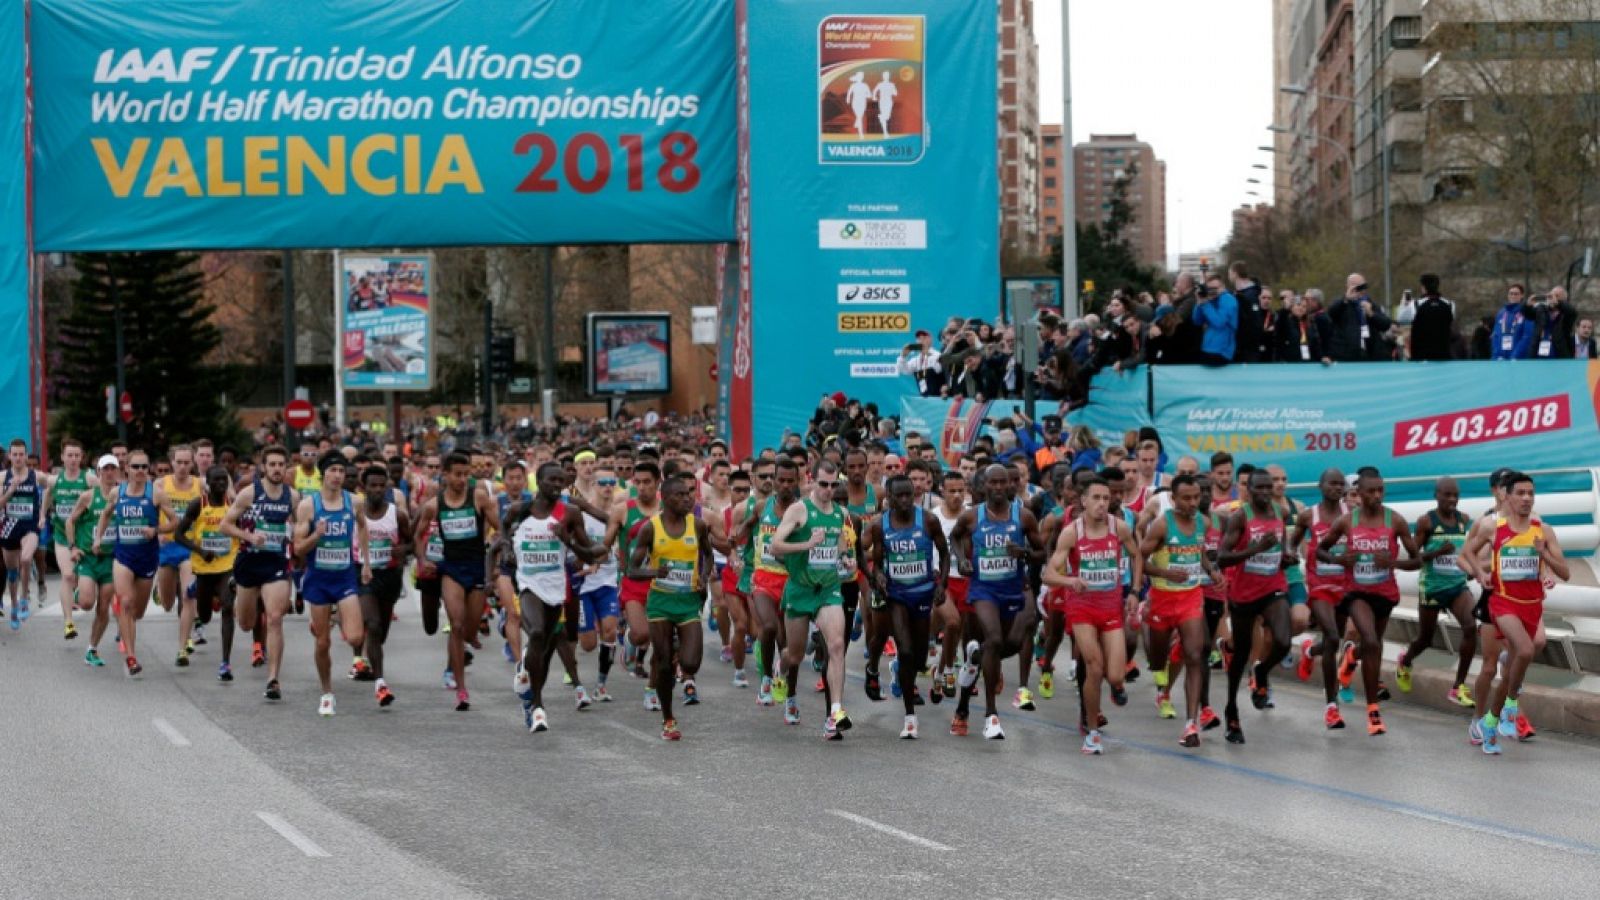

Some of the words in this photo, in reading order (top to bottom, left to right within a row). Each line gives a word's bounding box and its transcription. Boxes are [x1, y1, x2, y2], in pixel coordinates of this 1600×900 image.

[249, 46, 416, 82] Trinidad
[421, 45, 582, 80] Alfonso
[91, 91, 193, 123] World
[198, 89, 271, 123] Half
[271, 89, 434, 121] Marathon
[442, 87, 699, 126] Championships
[828, 145, 886, 157] VALENCIA
[888, 146, 913, 156] 2018
[91, 133, 485, 198] VALENCIA
[513, 131, 701, 194] 2018
[864, 222, 908, 232] TRINIDAD
[864, 232, 908, 241] ALFONSO
[841, 315, 908, 330] SEIKO
[1231, 407, 1278, 419] Trinidad
[1279, 408, 1324, 419] Alfonso
[1186, 421, 1215, 432] World
[1216, 421, 1238, 432] Half
[1238, 420, 1284, 432] Marathon
[1285, 420, 1357, 432] Championships
[1405, 402, 1559, 451] 24.03.2018
[1186, 432, 1297, 453] VALENCIA
[1304, 432, 1357, 452] 2018
[123, 505, 143, 518] USA
[263, 503, 289, 512] FRANCE
[891, 539, 917, 553] USA
[985, 533, 1012, 549] USA
[1352, 535, 1389, 550] KENYA
[893, 562, 924, 576] KORIR
[980, 558, 1014, 571] LAGAT
